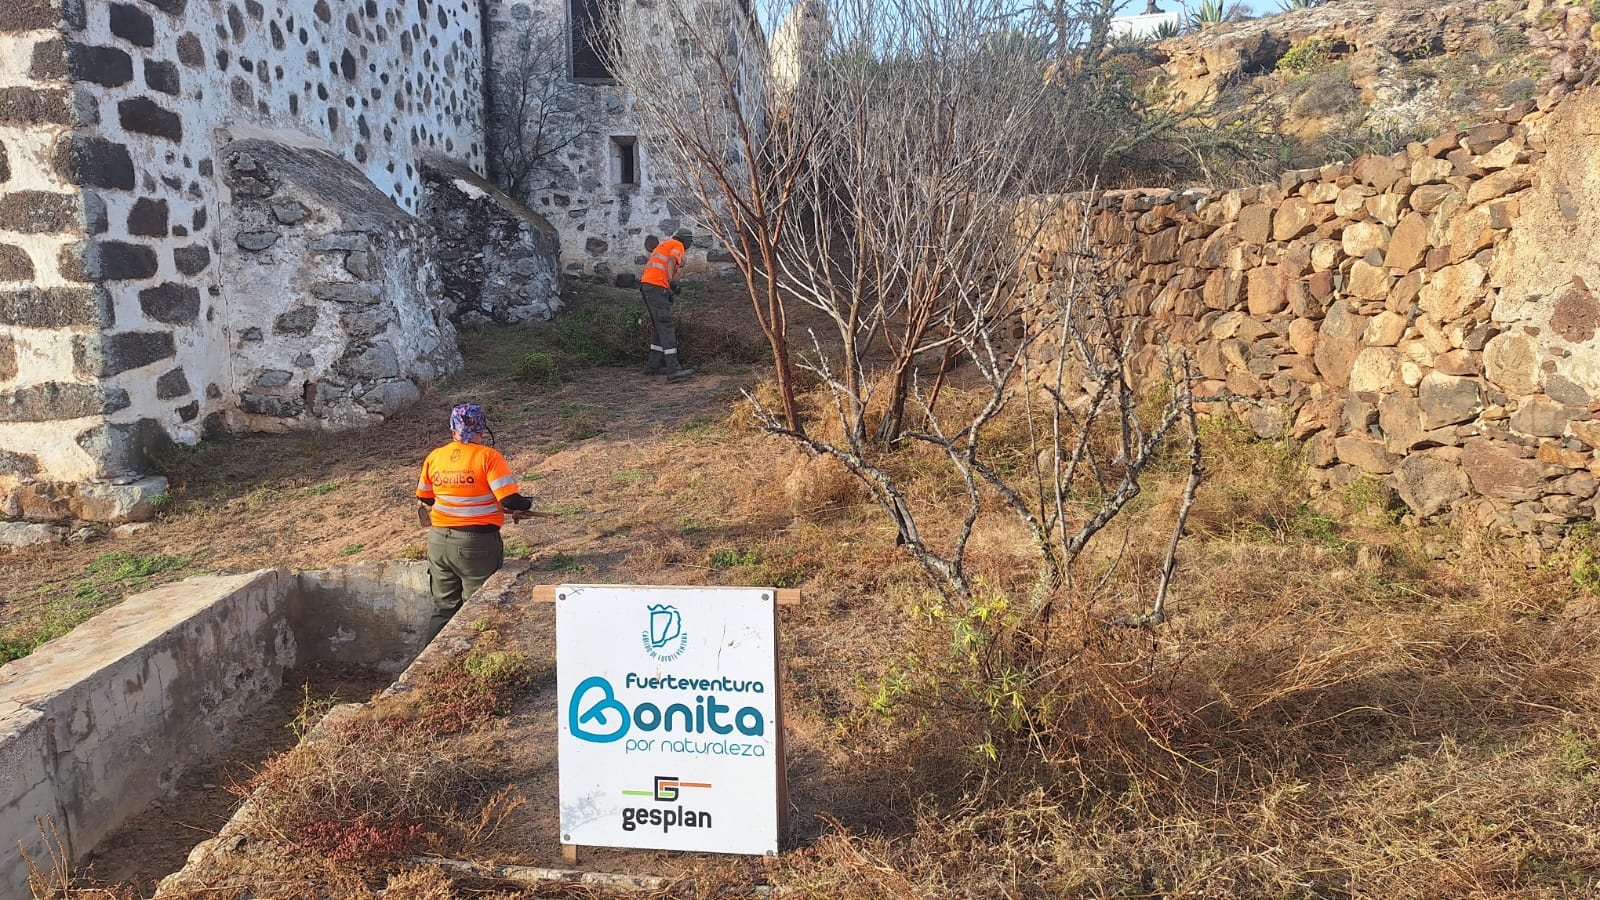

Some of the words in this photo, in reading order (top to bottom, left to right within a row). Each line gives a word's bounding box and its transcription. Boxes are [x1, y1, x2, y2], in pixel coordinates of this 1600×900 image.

[625, 672, 764, 694] Fuerteventura
[568, 675, 764, 744] Bonita
[625, 738, 655, 755] por
[660, 738, 765, 757] naturaleza
[621, 805, 713, 833] gesplan
